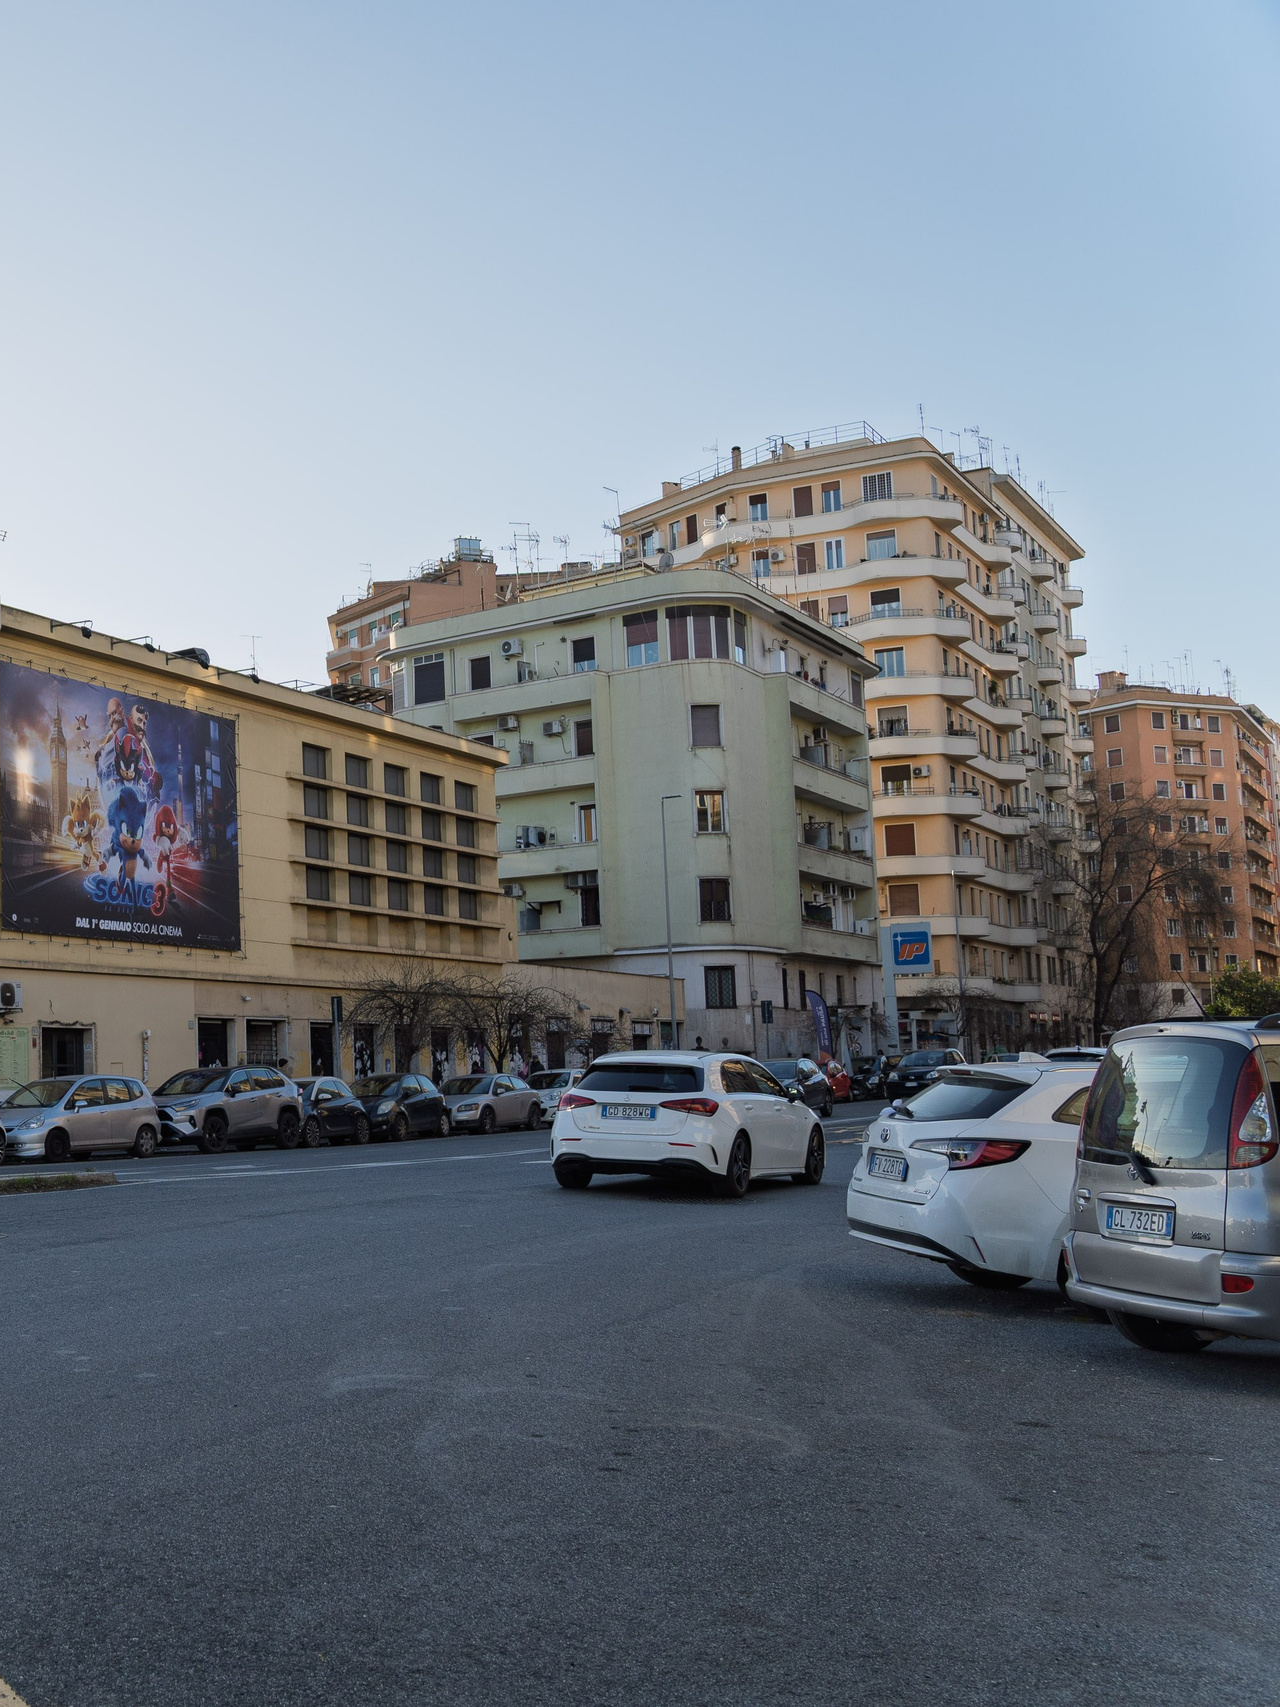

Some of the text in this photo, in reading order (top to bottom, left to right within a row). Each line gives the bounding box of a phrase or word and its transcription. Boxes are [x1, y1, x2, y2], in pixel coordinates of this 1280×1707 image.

[150, 882, 168, 917] 3
[75, 917, 90, 928] DAL
[99, 919, 132, 933] GENNAIO
[132, 922, 150, 934] SOLO
[150, 924, 159, 934] AL
[159, 924, 183, 937] CINEMA
[898, 942, 927, 960] IP
[1113, 1209, 1164, 1233] CL 732ED
